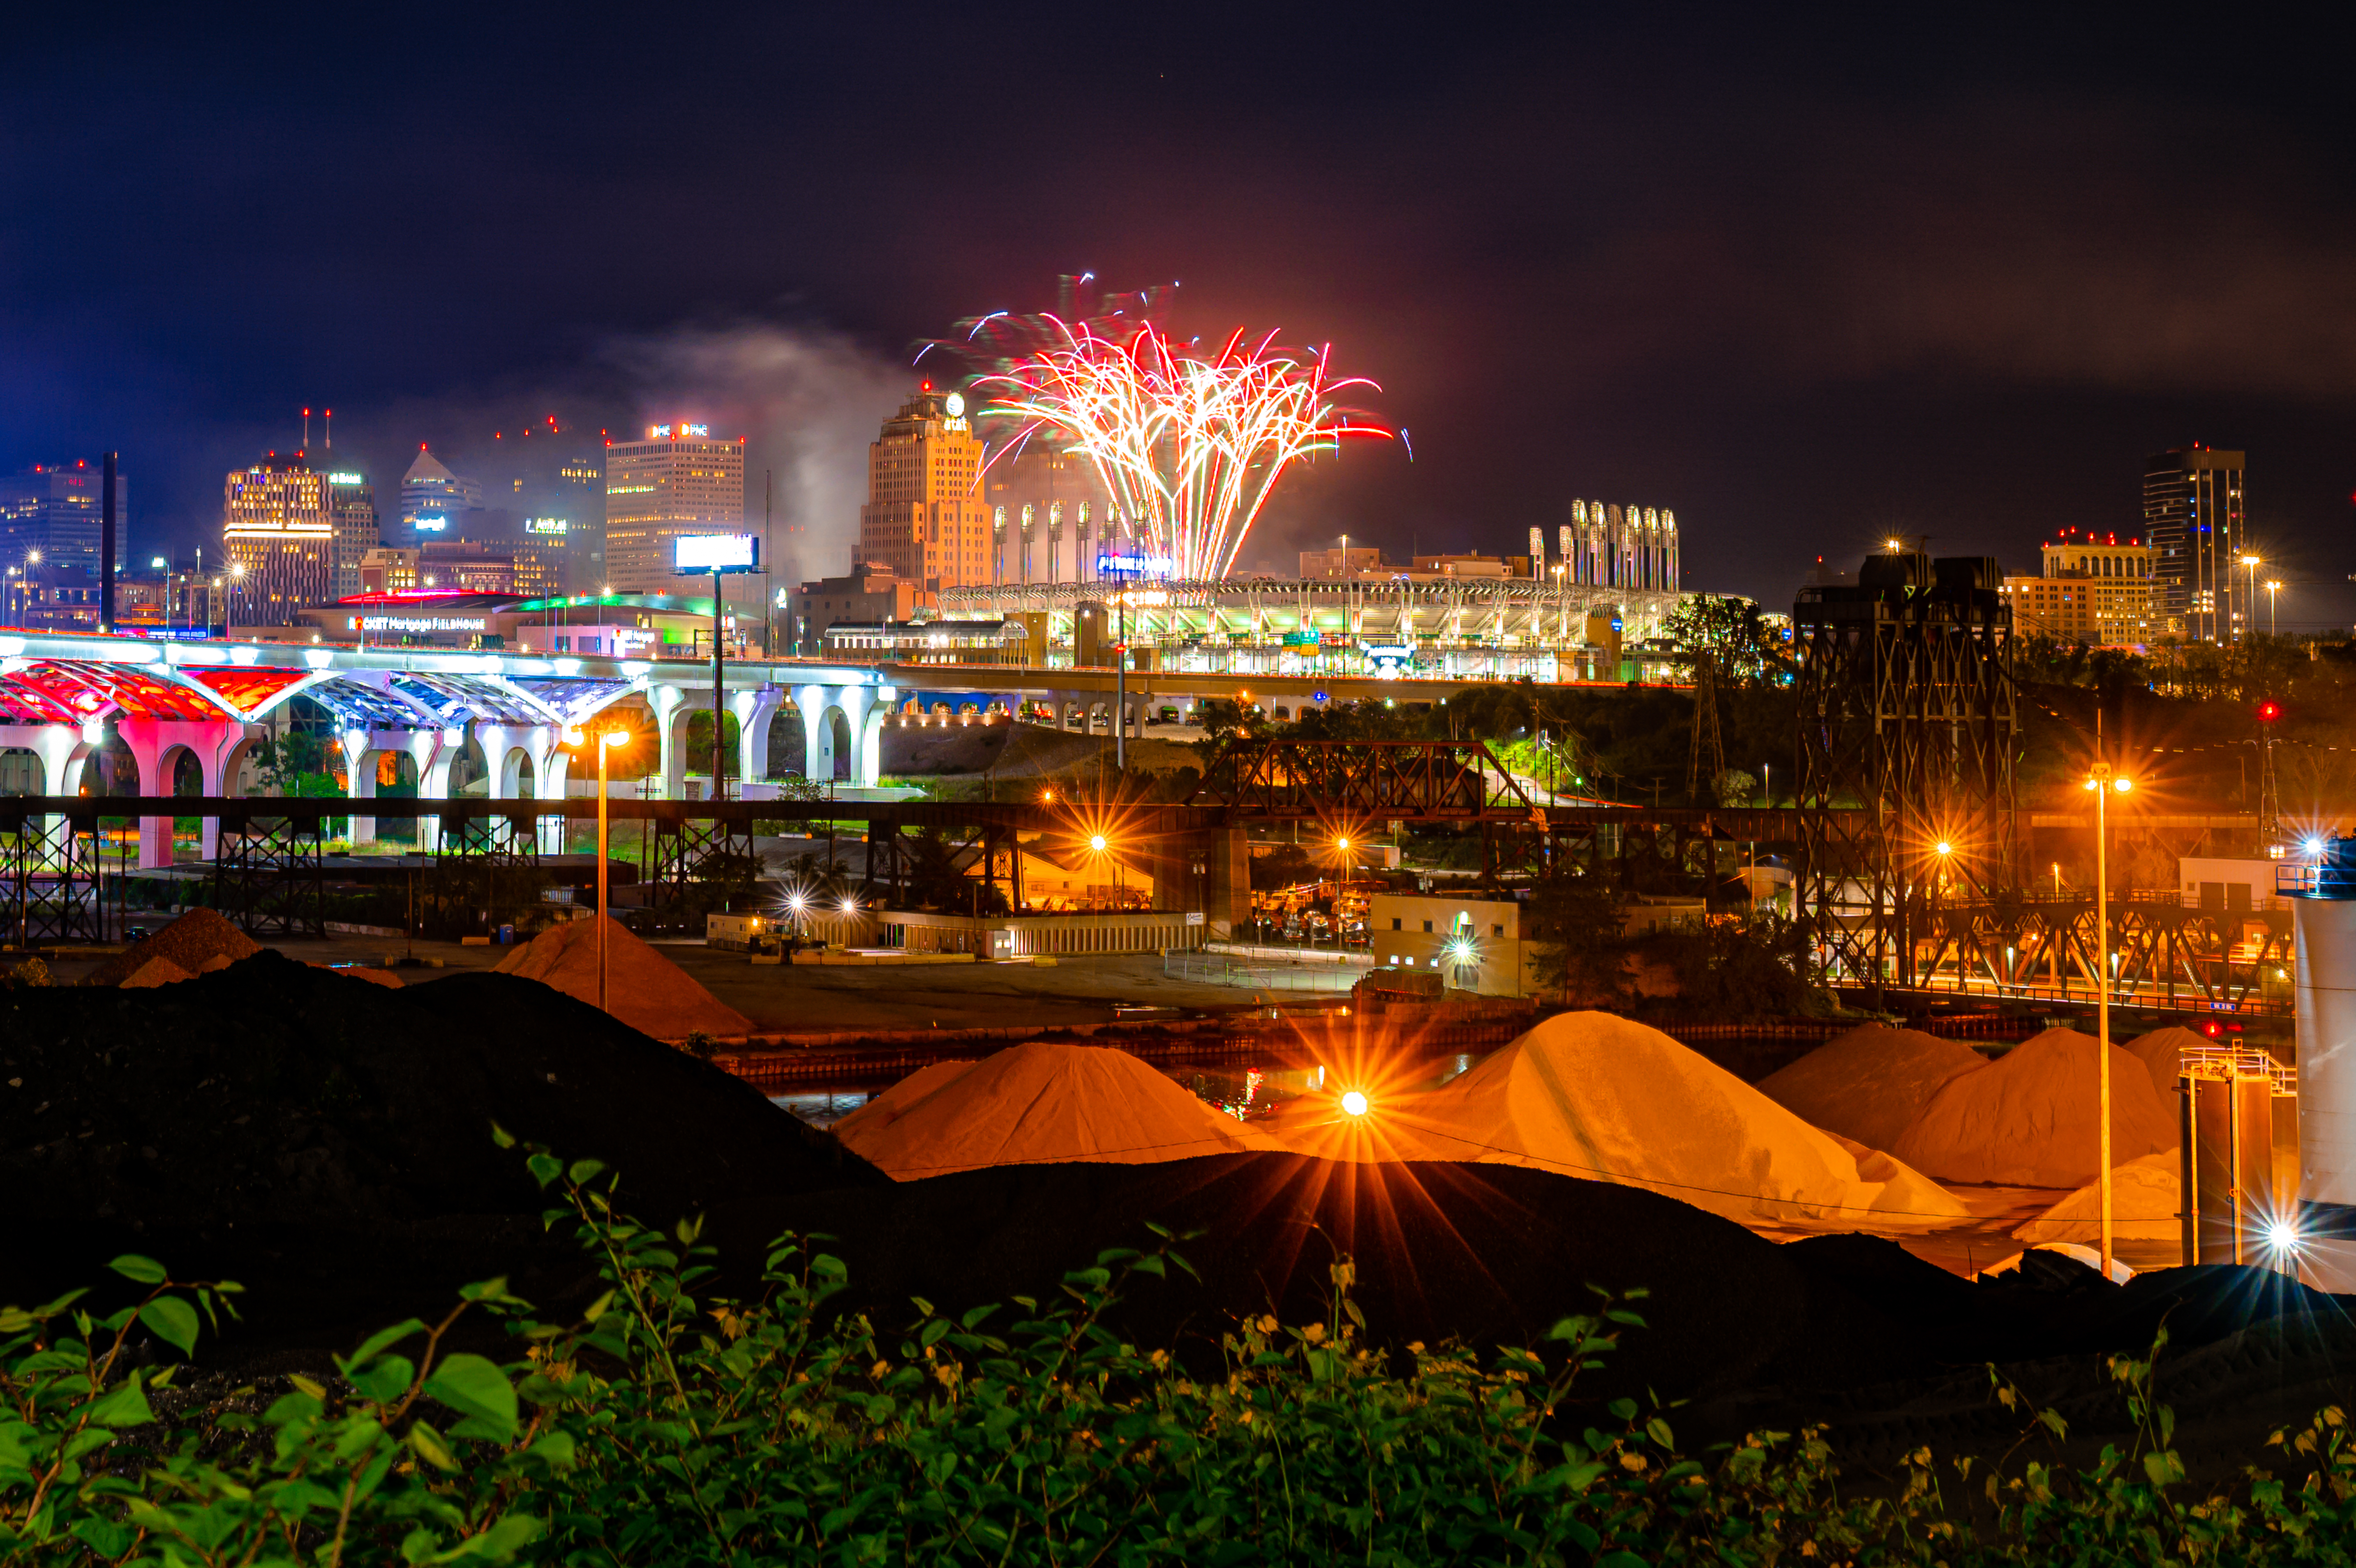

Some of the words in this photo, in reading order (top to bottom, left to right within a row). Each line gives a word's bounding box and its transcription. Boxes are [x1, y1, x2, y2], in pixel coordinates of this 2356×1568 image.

[690, 424, 707, 436] PNC
[348, 617, 388, 630] ROCKET
[389, 617, 432, 633] Mortgage
